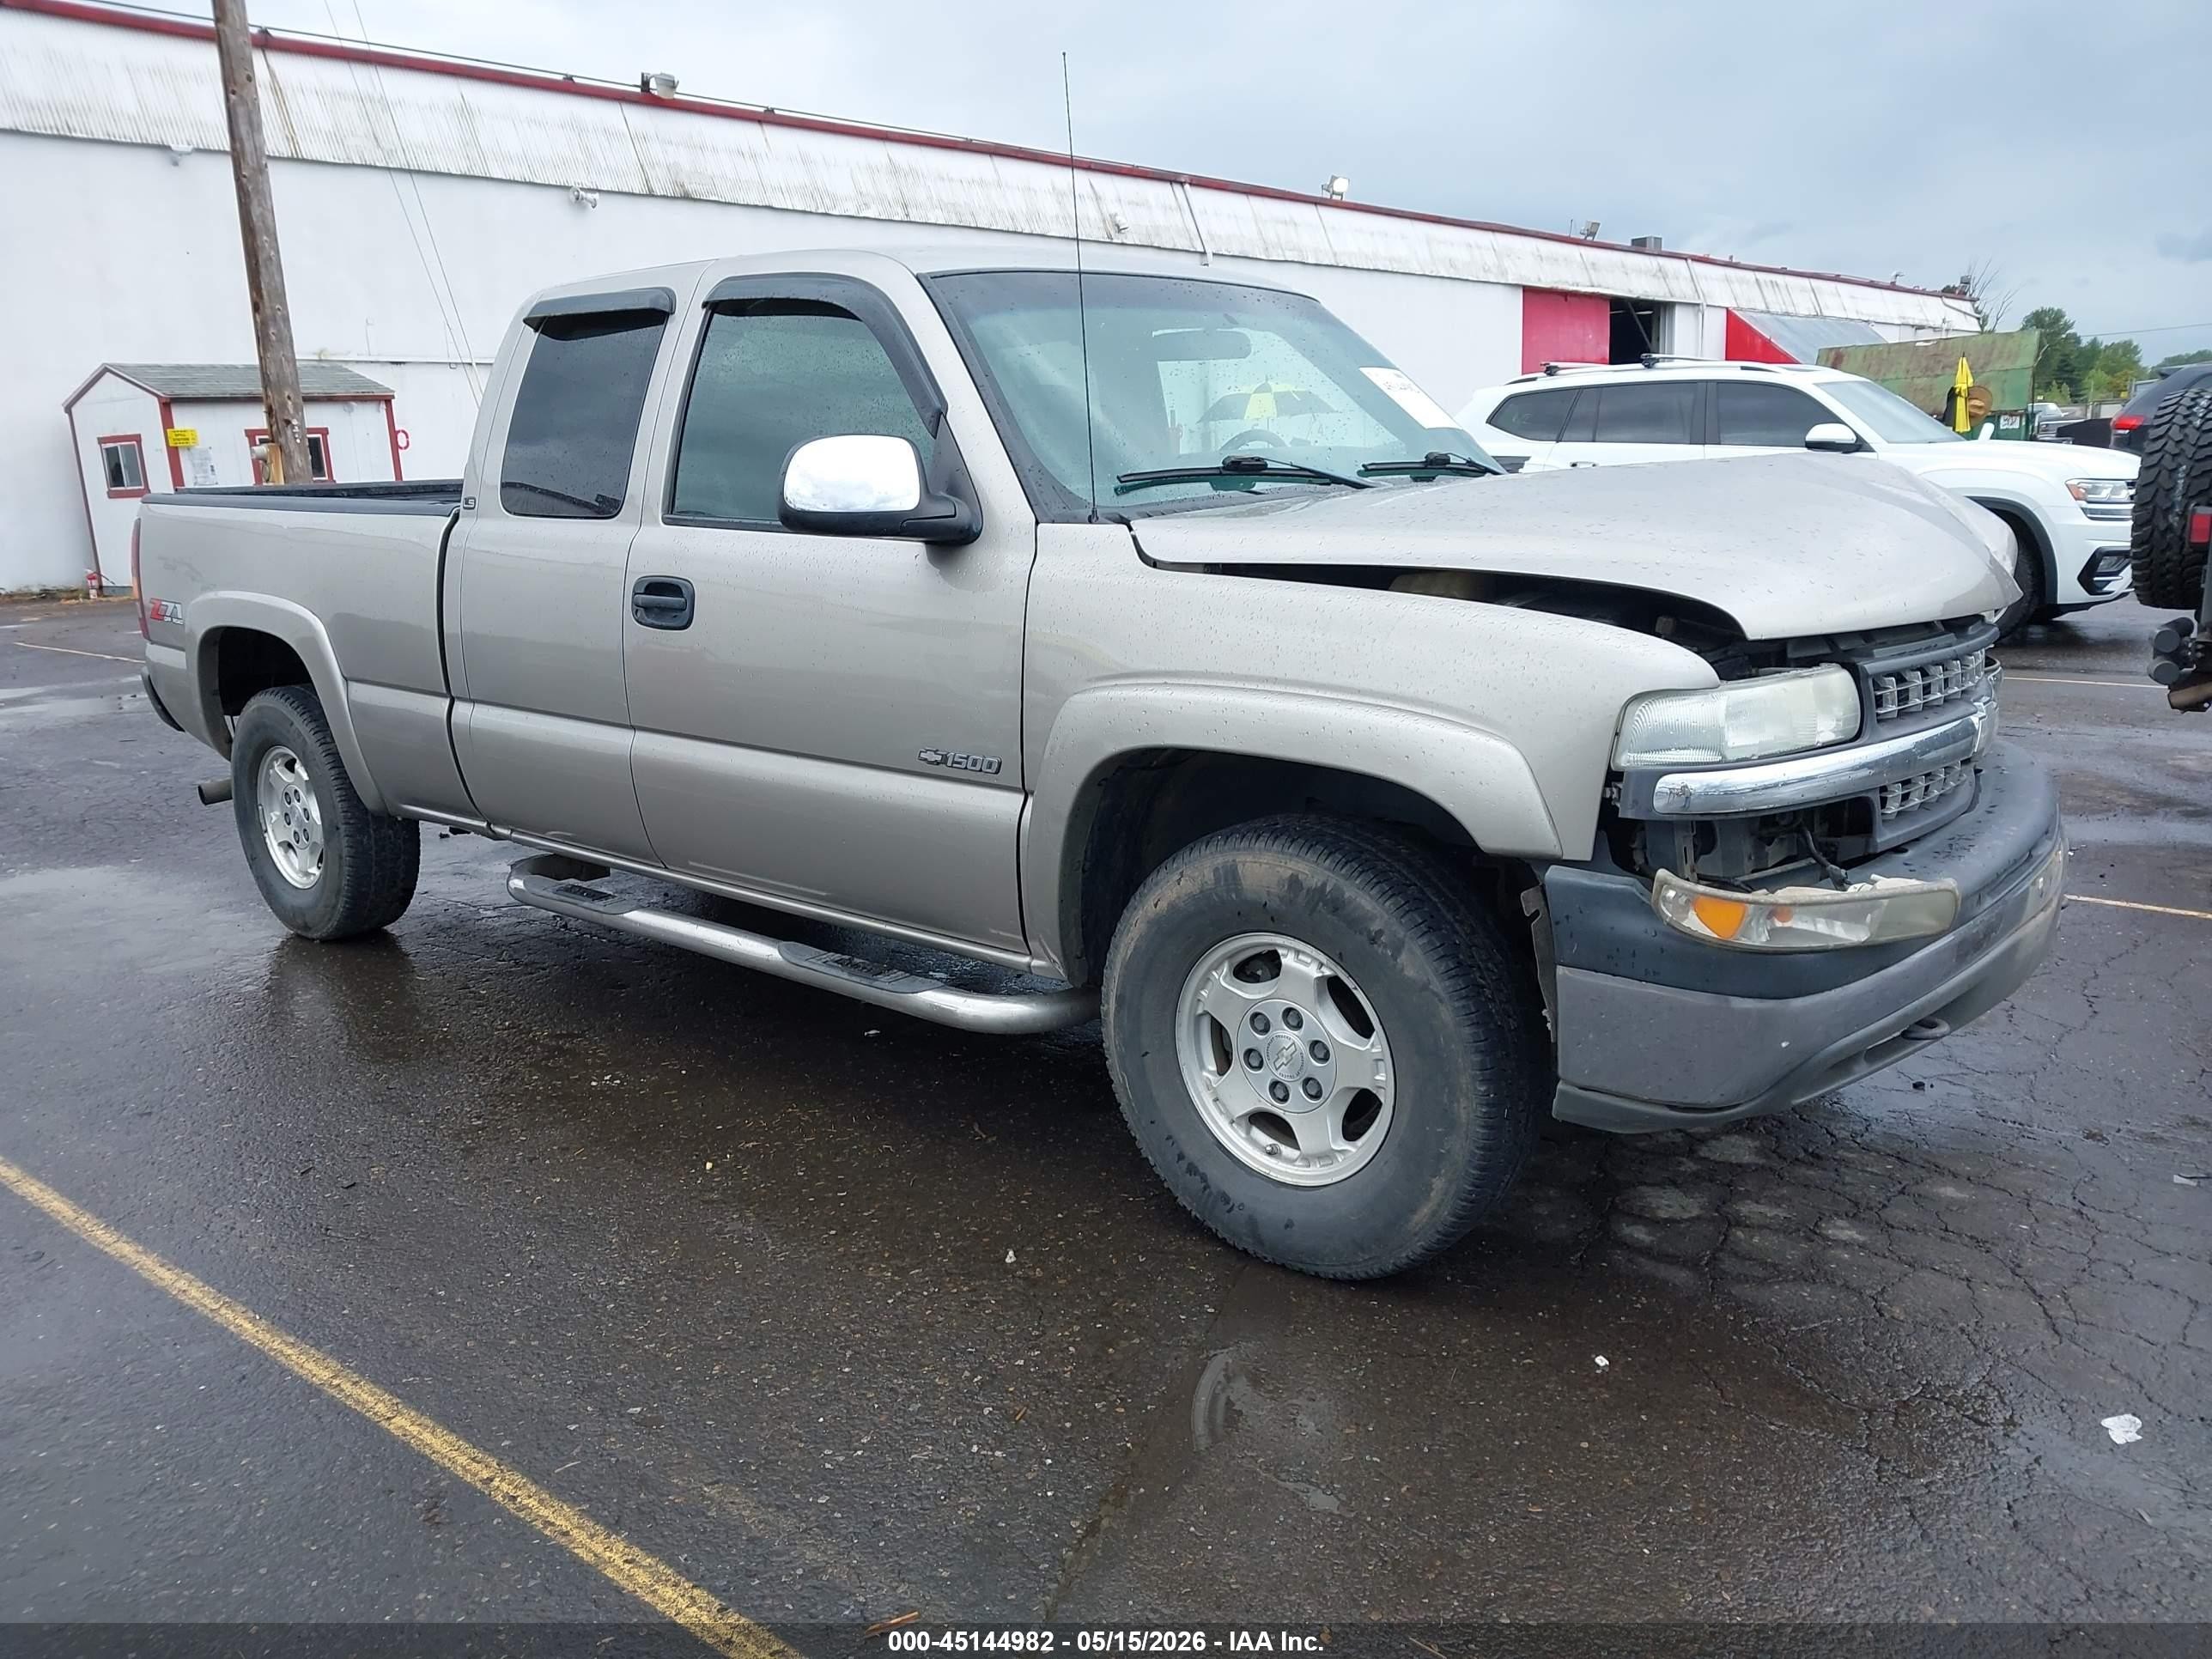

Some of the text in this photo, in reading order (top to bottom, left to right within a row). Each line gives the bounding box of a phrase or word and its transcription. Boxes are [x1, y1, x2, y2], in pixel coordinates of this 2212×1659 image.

[464, 498, 476, 508] LS
[150, 598, 183, 621] Z71
[945, 752, 1002, 774] 1500
